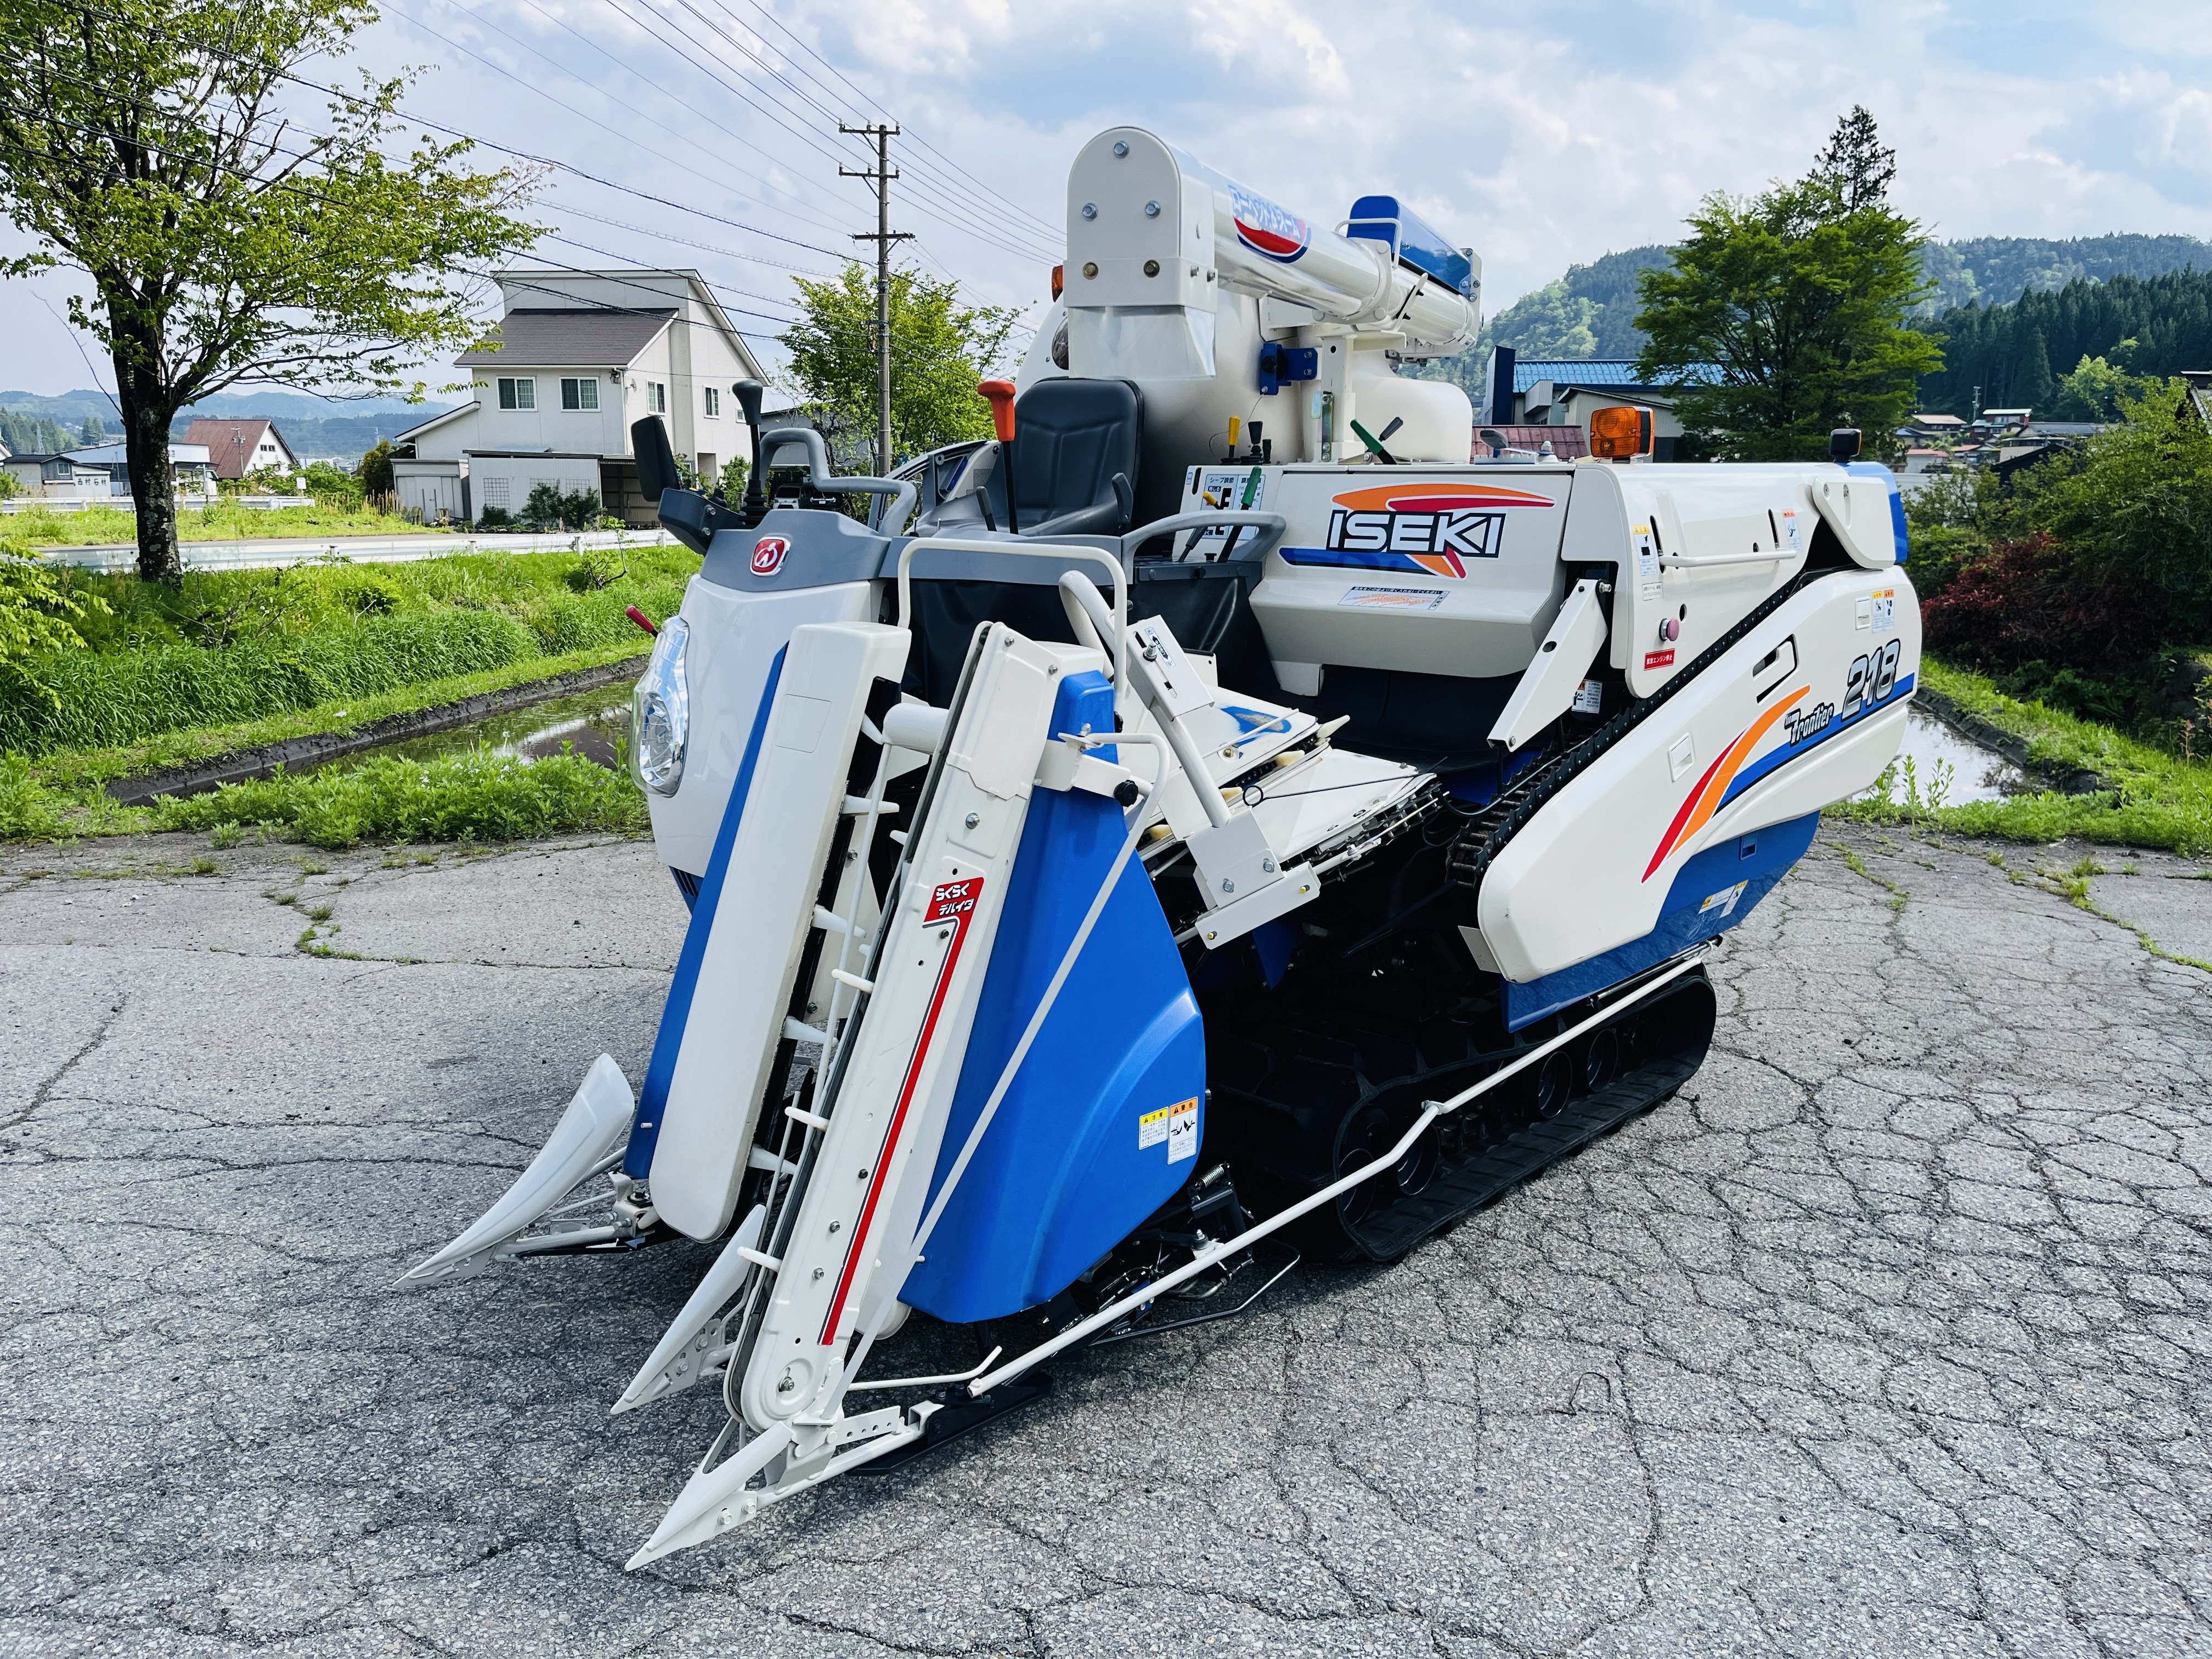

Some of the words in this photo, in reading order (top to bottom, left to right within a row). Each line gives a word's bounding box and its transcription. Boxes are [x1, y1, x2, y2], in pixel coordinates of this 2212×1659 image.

[1325, 510, 1506, 558] ISEKI
[1841, 639, 1900, 723] 218
[1784, 702, 1834, 747] Frontier
[935, 882, 970, 901] らくらく
[939, 898, 974, 916] デバイダ
